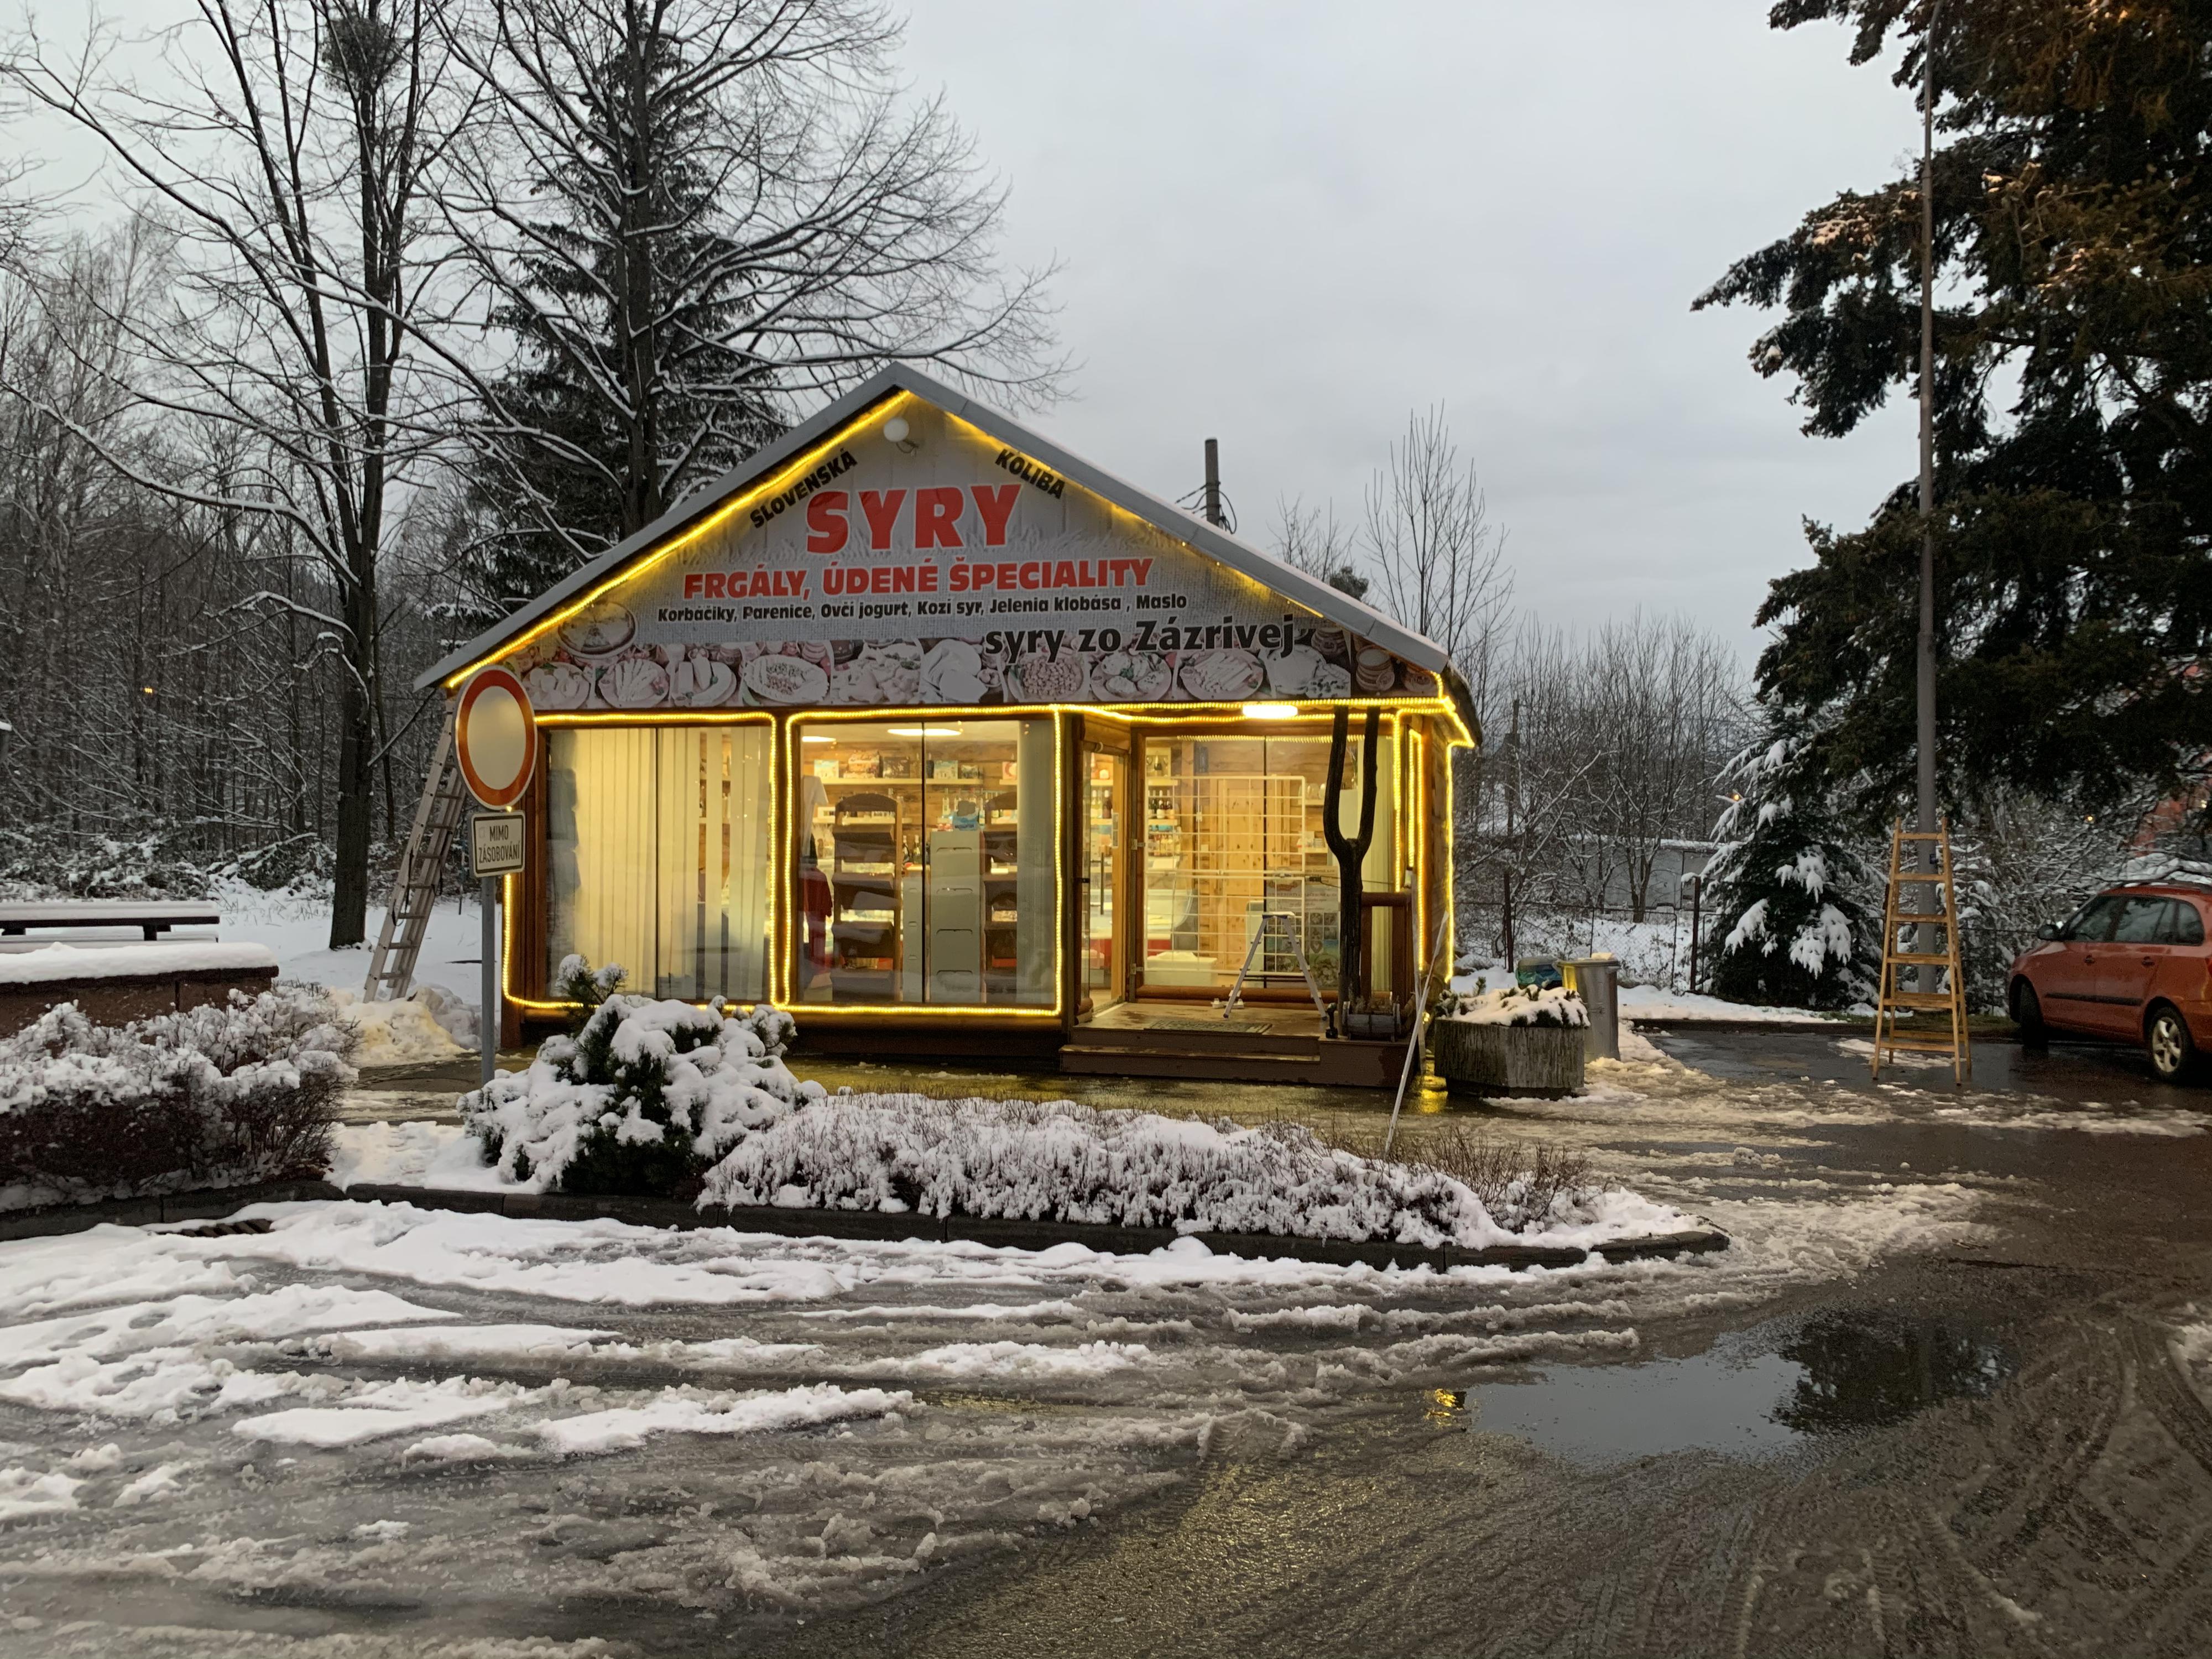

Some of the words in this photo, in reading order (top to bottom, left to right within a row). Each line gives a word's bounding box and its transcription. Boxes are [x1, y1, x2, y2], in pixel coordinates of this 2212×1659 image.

[750, 448, 858, 529] SLOVENSKÁ
[995, 448, 1065, 499] KOLIBA
[807, 484, 1021, 554] SYRY
[684, 564, 810, 601] FRGÁLY,
[823, 557, 938, 595] ÚDENÉ
[949, 556, 1153, 592] ŠPECIALITY
[743, 604, 815, 620] Parenice,
[859, 601, 911, 619] jogurt,
[957, 601, 984, 616] syr,
[990, 597, 1048, 613] Jelenia
[1136, 593, 1186, 609] Maslo
[985, 629, 1065, 664] syry
[1078, 628, 1121, 652] zo
[1135, 613, 1293, 658] Zázrivej
[478, 840, 520, 863] ZÁSOBOVÁNÍ
[489, 825, 509, 841] MIMO
